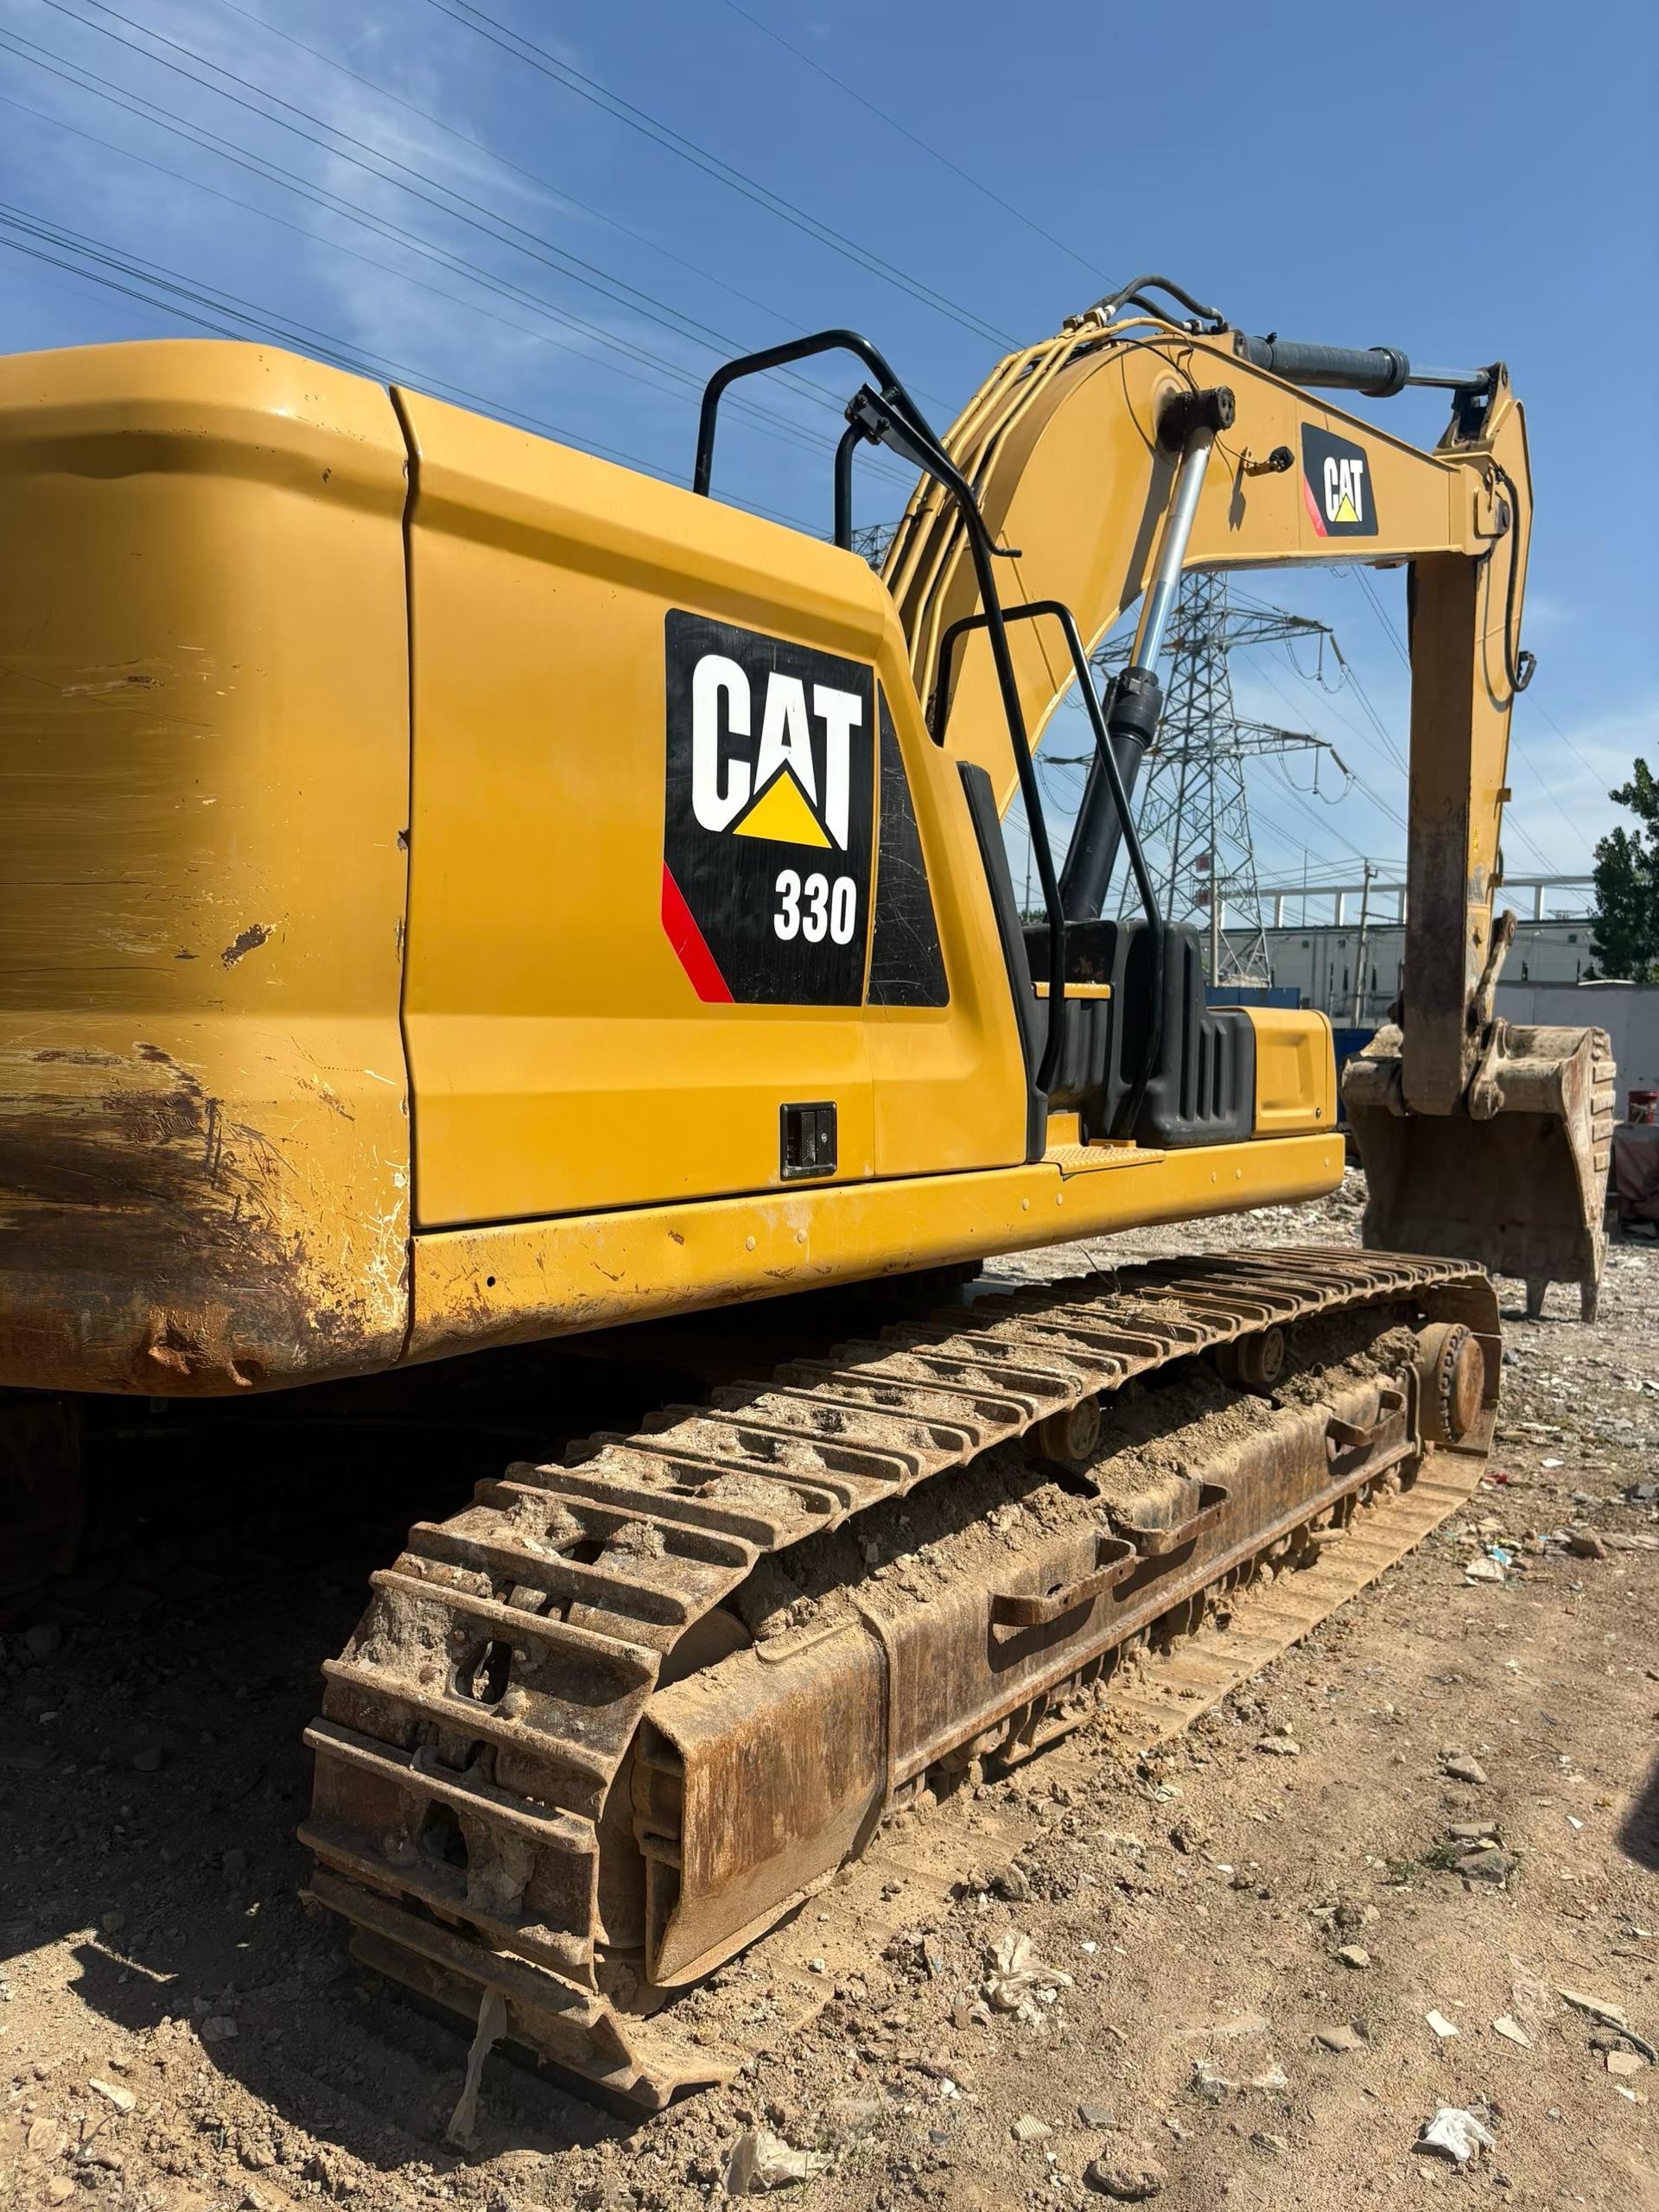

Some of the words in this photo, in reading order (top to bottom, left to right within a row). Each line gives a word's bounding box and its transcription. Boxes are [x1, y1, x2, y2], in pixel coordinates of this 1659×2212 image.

[1324, 456, 1363, 522] CAT
[691, 654, 862, 851] CAT
[773, 868, 857, 945] 330
